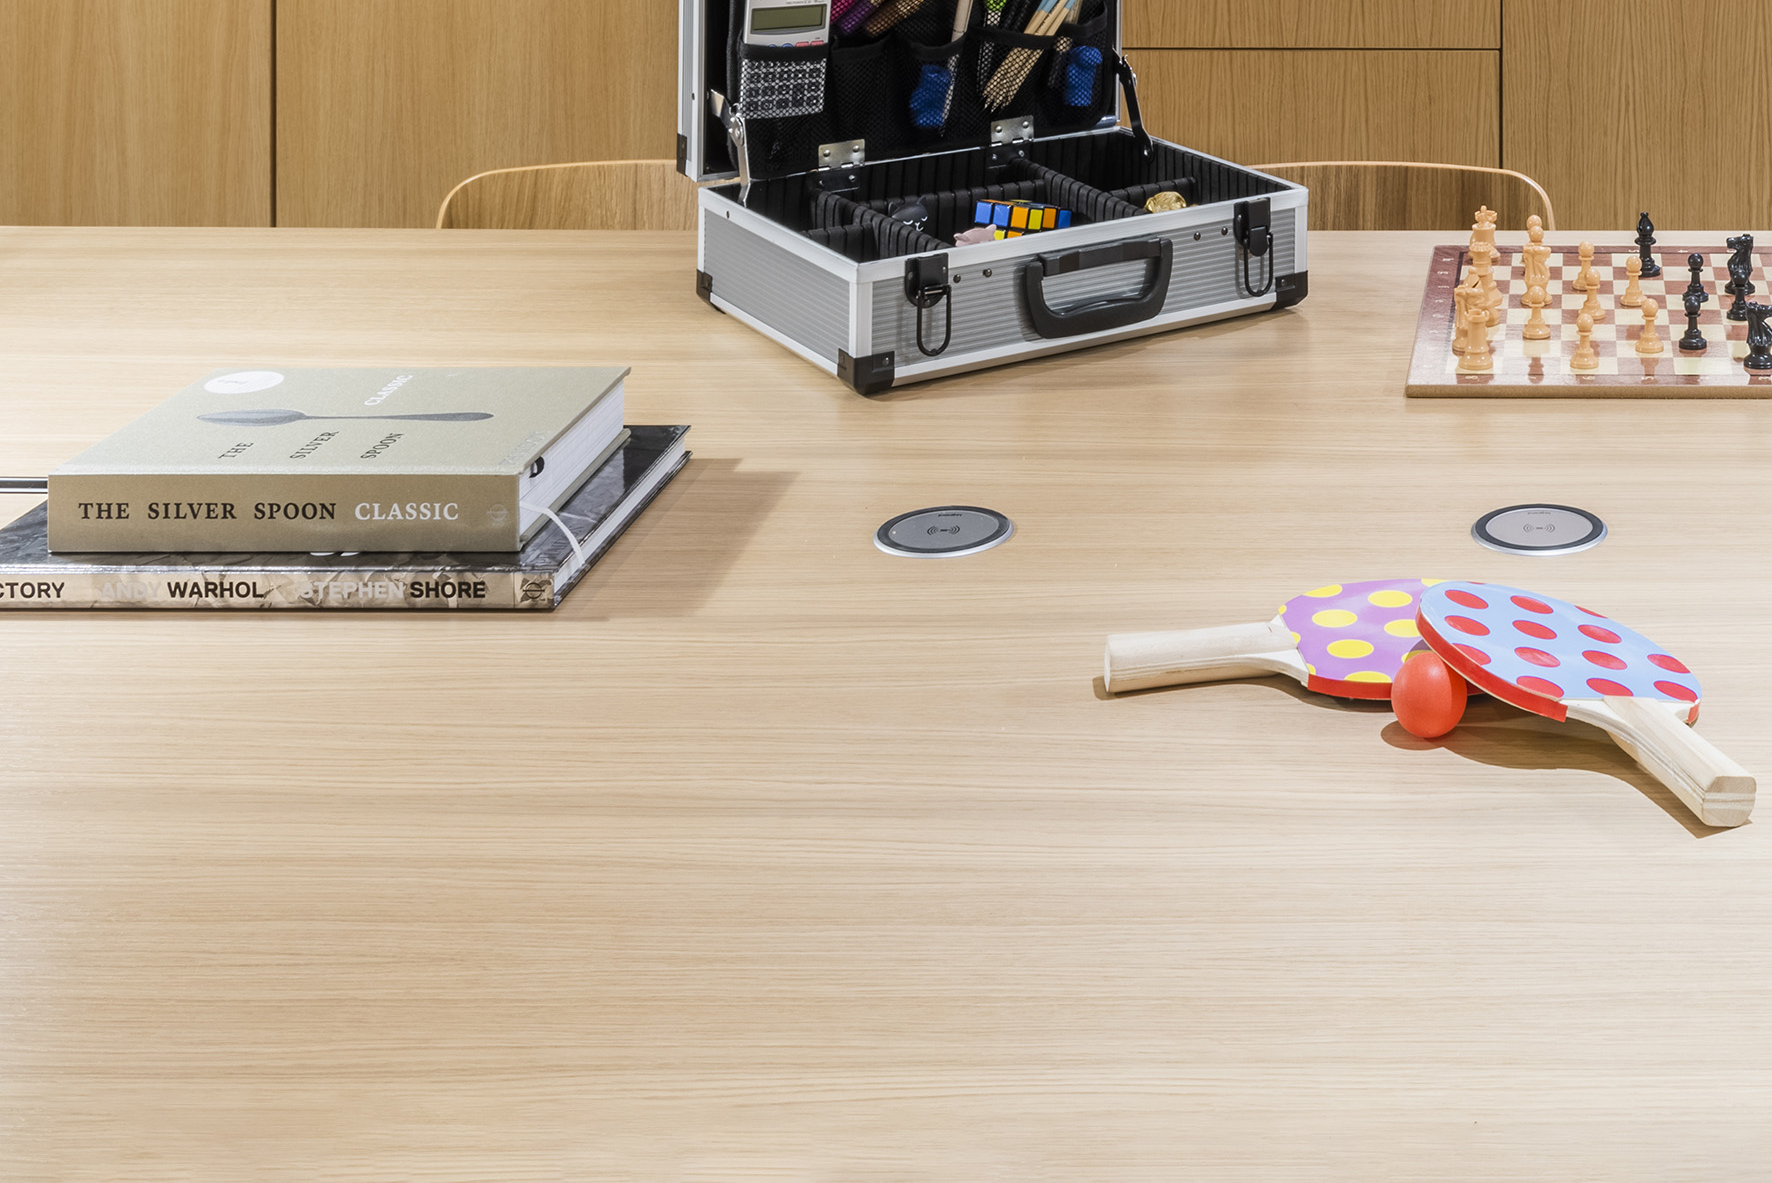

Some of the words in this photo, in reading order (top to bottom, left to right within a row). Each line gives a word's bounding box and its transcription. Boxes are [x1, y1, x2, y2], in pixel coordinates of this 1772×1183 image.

[364, 374, 413, 406] CLASSIC
[218, 442, 254, 459] THE
[289, 430, 339, 460] SILVER
[360, 432, 405, 460] SPOON
[78, 502, 130, 520] THE
[147, 502, 237, 520] SILVER
[253, 502, 337, 520] SPOON
[354, 502, 459, 521] CLASSIC
[100, 581, 162, 599] ANDY
[167, 581, 265, 599] WARHOL
[300, 581, 403, 599] STEPHEN
[410, 581, 486, 599] SHORE
